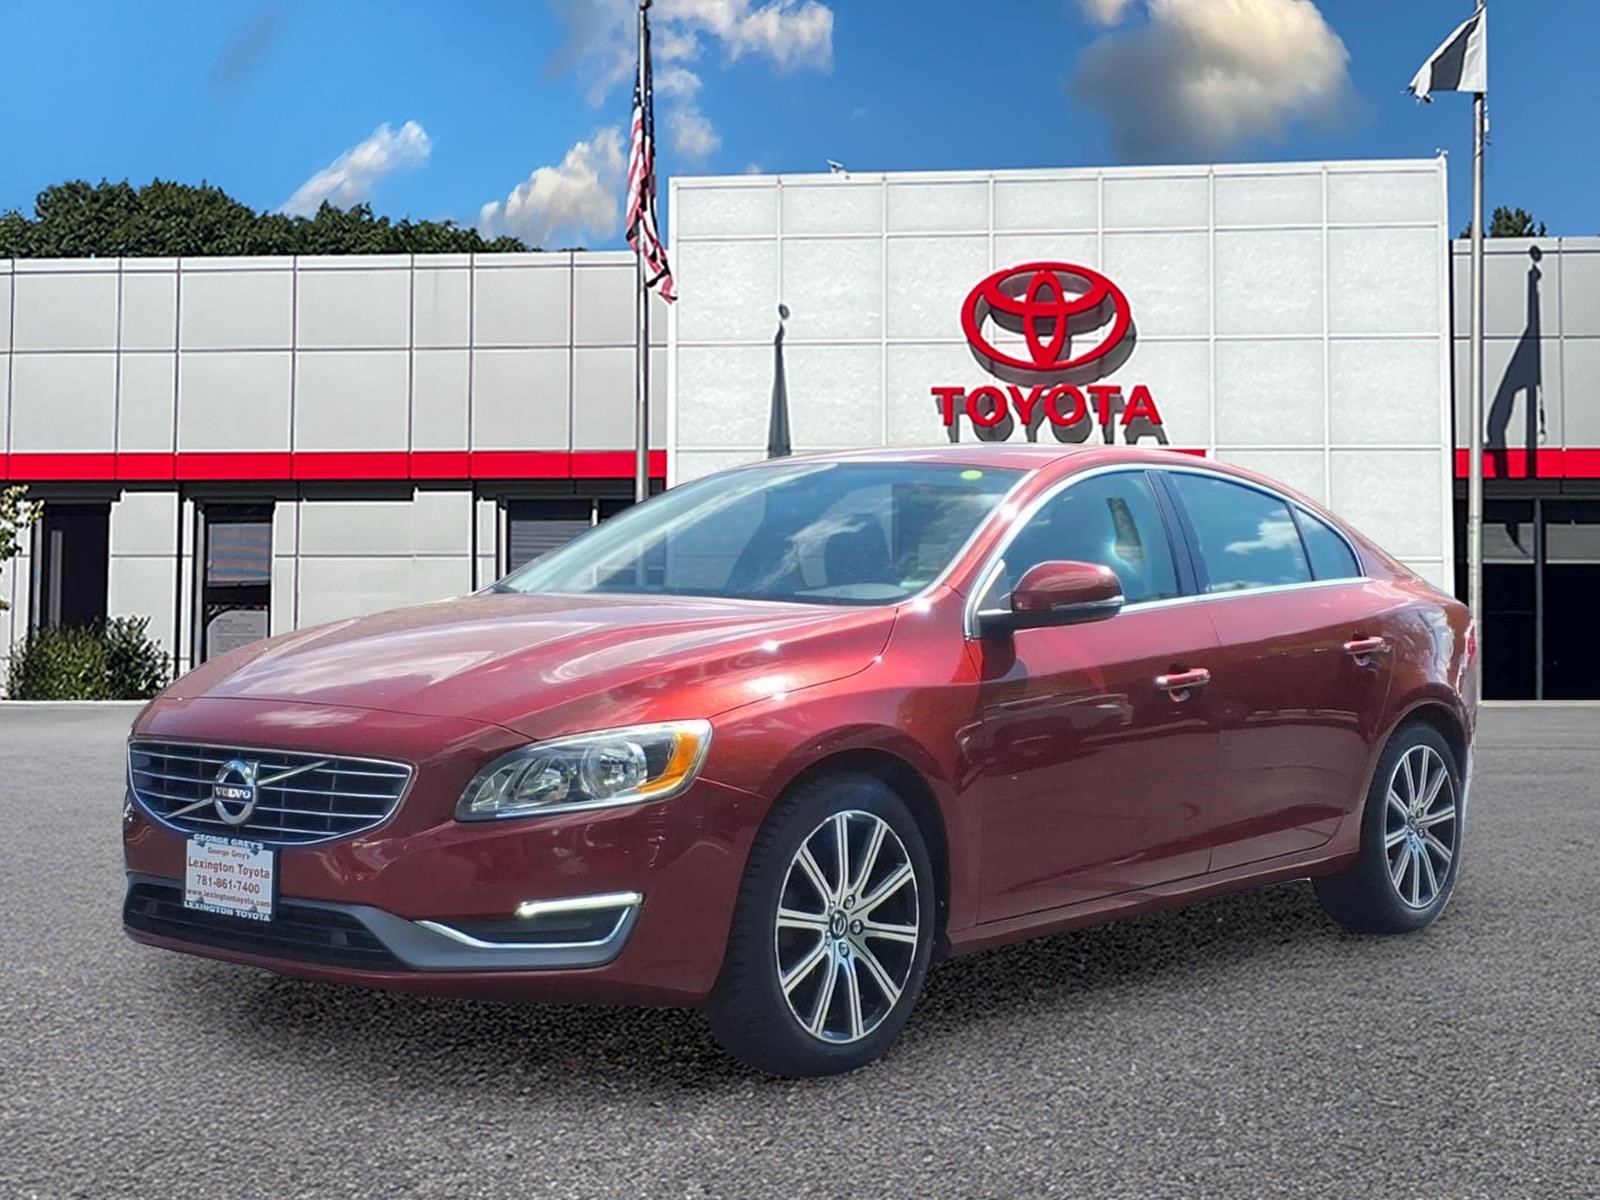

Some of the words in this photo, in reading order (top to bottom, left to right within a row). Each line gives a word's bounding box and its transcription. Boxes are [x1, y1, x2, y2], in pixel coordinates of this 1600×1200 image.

[931, 384, 1162, 427] TOYOTA
[207, 846, 230, 857] George
[188, 856, 235, 873] Lexington
[238, 863, 270, 880] Toyota
[196, 874, 260, 894] 781-861-7400
[184, 900, 233, 915] LEXINGTON
[235, 909, 271, 922] TOYOTA
